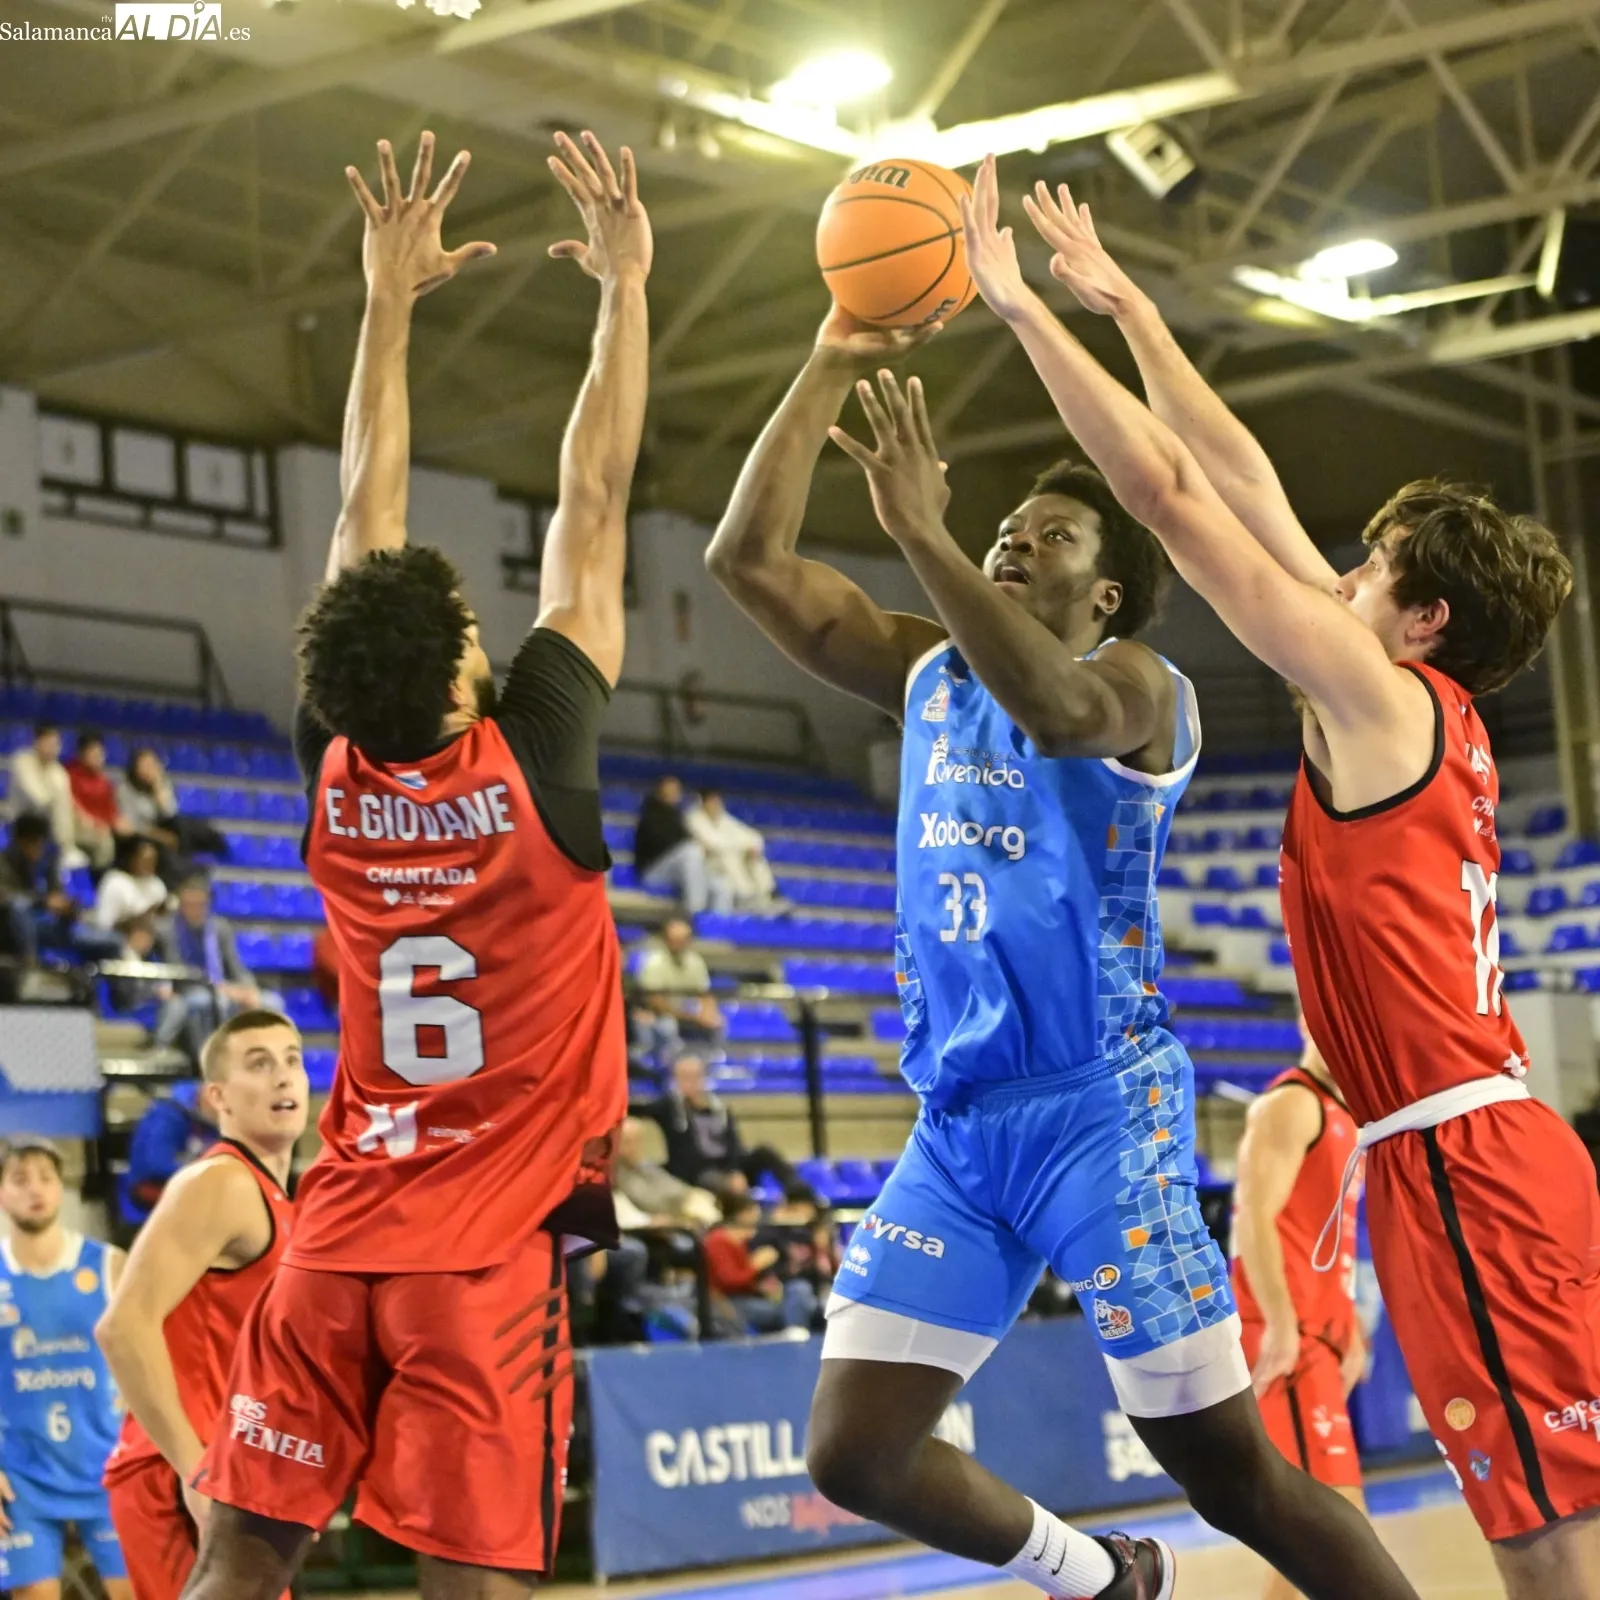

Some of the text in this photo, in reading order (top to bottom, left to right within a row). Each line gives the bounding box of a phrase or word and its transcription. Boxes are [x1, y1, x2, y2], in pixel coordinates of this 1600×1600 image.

[918, 812, 1027, 861] Xoborg
[366, 867, 477, 885] CHANTADA
[938, 871, 988, 943] 33
[378, 935, 485, 1087] 6
[46, 1401, 72, 1443] 6
[645, 1418, 808, 1488] CASTILL
